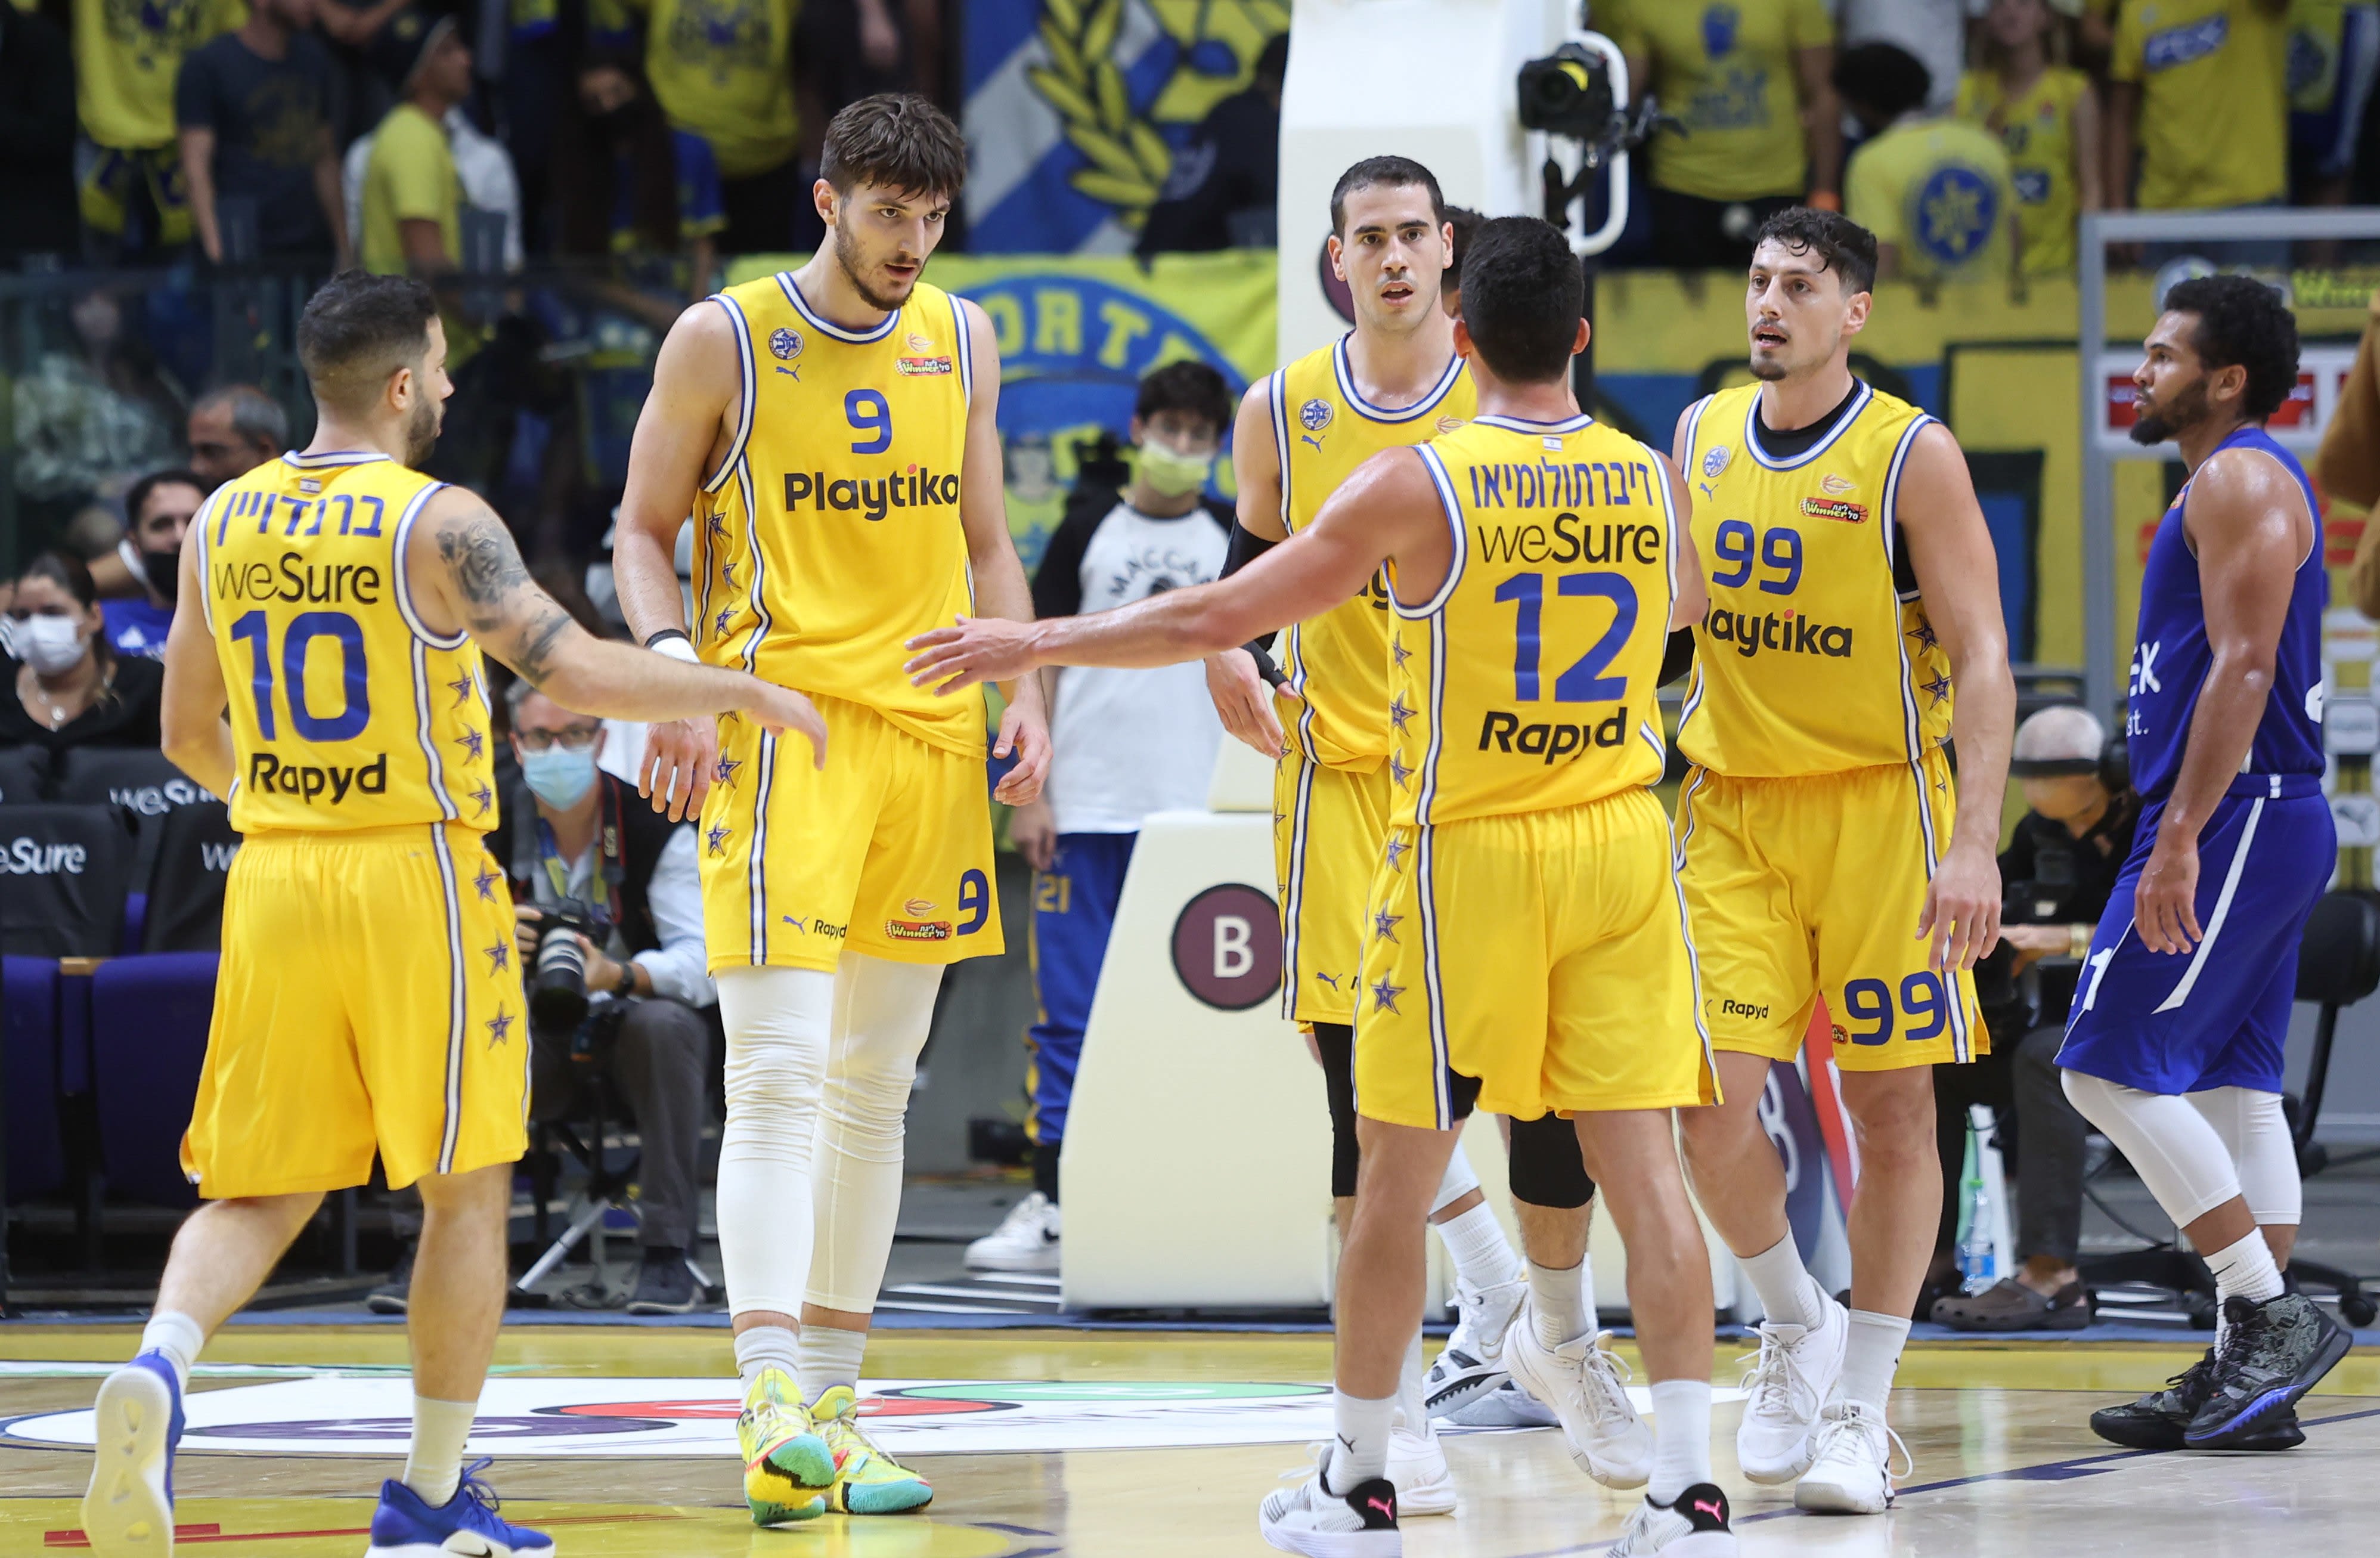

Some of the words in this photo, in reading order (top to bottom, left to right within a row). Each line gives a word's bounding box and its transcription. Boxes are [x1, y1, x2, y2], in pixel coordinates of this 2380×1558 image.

[901, 361, 938, 373] Winner
[844, 389, 892, 454] 9
[784, 463, 959, 521] Playtika
[1469, 456, 1653, 508] דיברתולומיאו
[216, 491, 385, 547] ברנדויין
[1806, 502, 1848, 518] Winner
[1477, 513, 1660, 564] weSure
[1711, 519, 1803, 595] 99
[215, 552, 380, 605] weSure
[1108, 544, 1213, 596] MACCA
[1494, 572, 1639, 703] 12
[231, 611, 370, 742] 10
[249, 752, 387, 806] Rapyd
[957, 868, 990, 936] 9
[813, 919, 848, 940] Rapyd
[892, 924, 935, 938] Winner
[1213, 915, 1255, 979] B
[1722, 999, 1769, 1020] Rapyd
[1844, 970, 1947, 1046] 99
